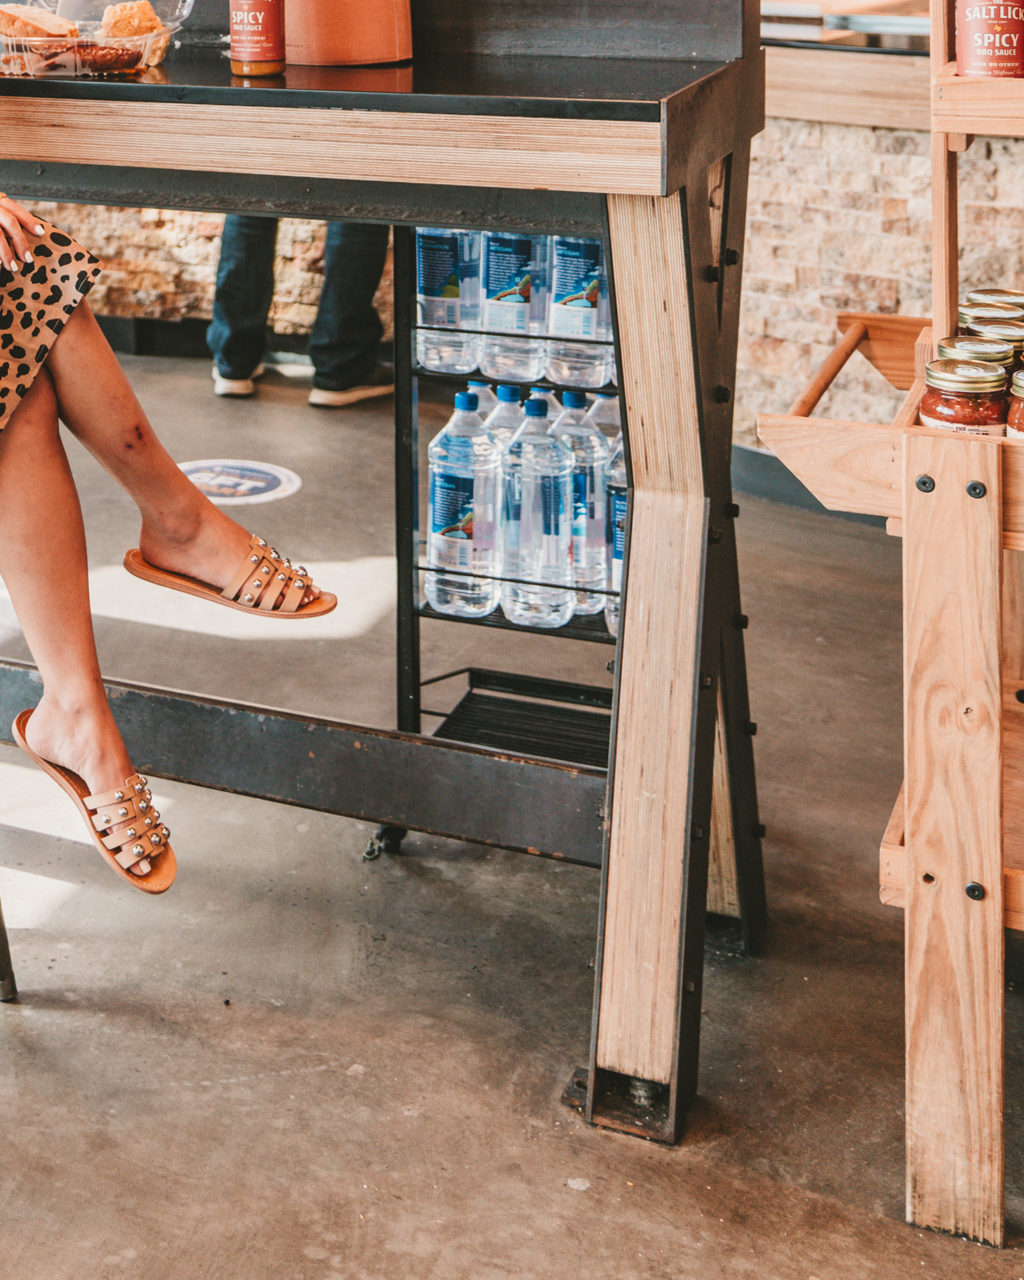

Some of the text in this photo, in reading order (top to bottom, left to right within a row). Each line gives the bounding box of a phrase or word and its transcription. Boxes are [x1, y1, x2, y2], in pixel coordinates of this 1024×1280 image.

[232, 11, 265, 24] SPICY
[965, 6, 997, 22] SALT
[973, 33, 1020, 47] SPICY
[995, 48, 1017, 56] SAUCE
